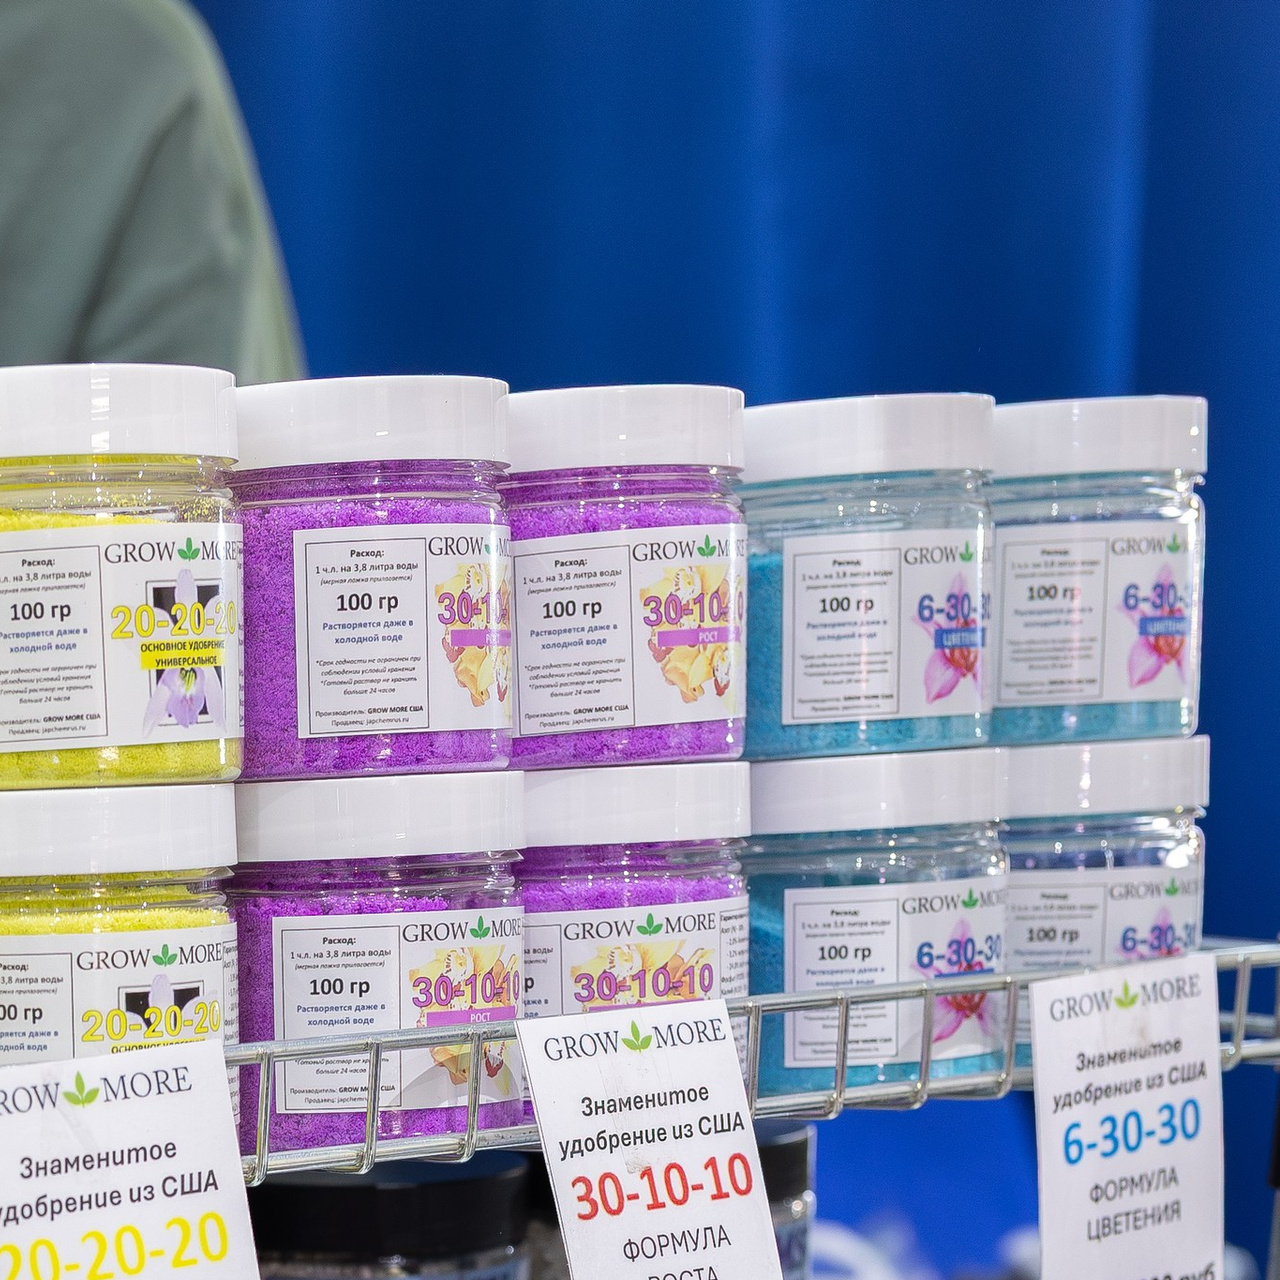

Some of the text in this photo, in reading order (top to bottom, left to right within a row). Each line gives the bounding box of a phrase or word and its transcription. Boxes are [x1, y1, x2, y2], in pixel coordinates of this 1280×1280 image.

[316, 566, 320, 574] 1
[354, 564, 366, 572] 3,8
[396, 562, 418, 570] воды
[350, 549, 384, 558] Расход:
[111, 600, 236, 639] 20-20-20
[336, 592, 398, 613] 100 гр
[322, 620, 380, 630] Растворяется
[383, 620, 402, 628] даже
[335, 634, 379, 644] холодной
[141, 642, 186, 652] ОСНОВНОЕ
[155, 656, 217, 667] УНИВЕРСАЛЬНОЕ
[562, 912, 717, 942] GROW MORE
[412, 970, 520, 1007] 30-10-10
[573, 962, 714, 1004] 30-10-10
[81, 999, 221, 1042] 20-20-20
[471, 1013, 490, 1022] РОСТ
[1076, 1038, 1183, 1072] Знаменитое
[100, 1066, 191, 1103] MORE
[1053, 1064, 1207, 1113] удобрение из США
[1064, 1098, 1201, 1165] 6-30-30
[20, 1141, 177, 1179] Знаменитое
[128, 1183, 155, 1202] из
[161, 1170, 219, 1198] США
[571, 1153, 753, 1221] 30-10-10
[1090, 1167, 1178, 1204] ФОРМУЛА
[1088, 1202, 1181, 1242] ЦВЕТЕНИЯ
[623, 1226, 731, 1262] ФОРМУЛА
